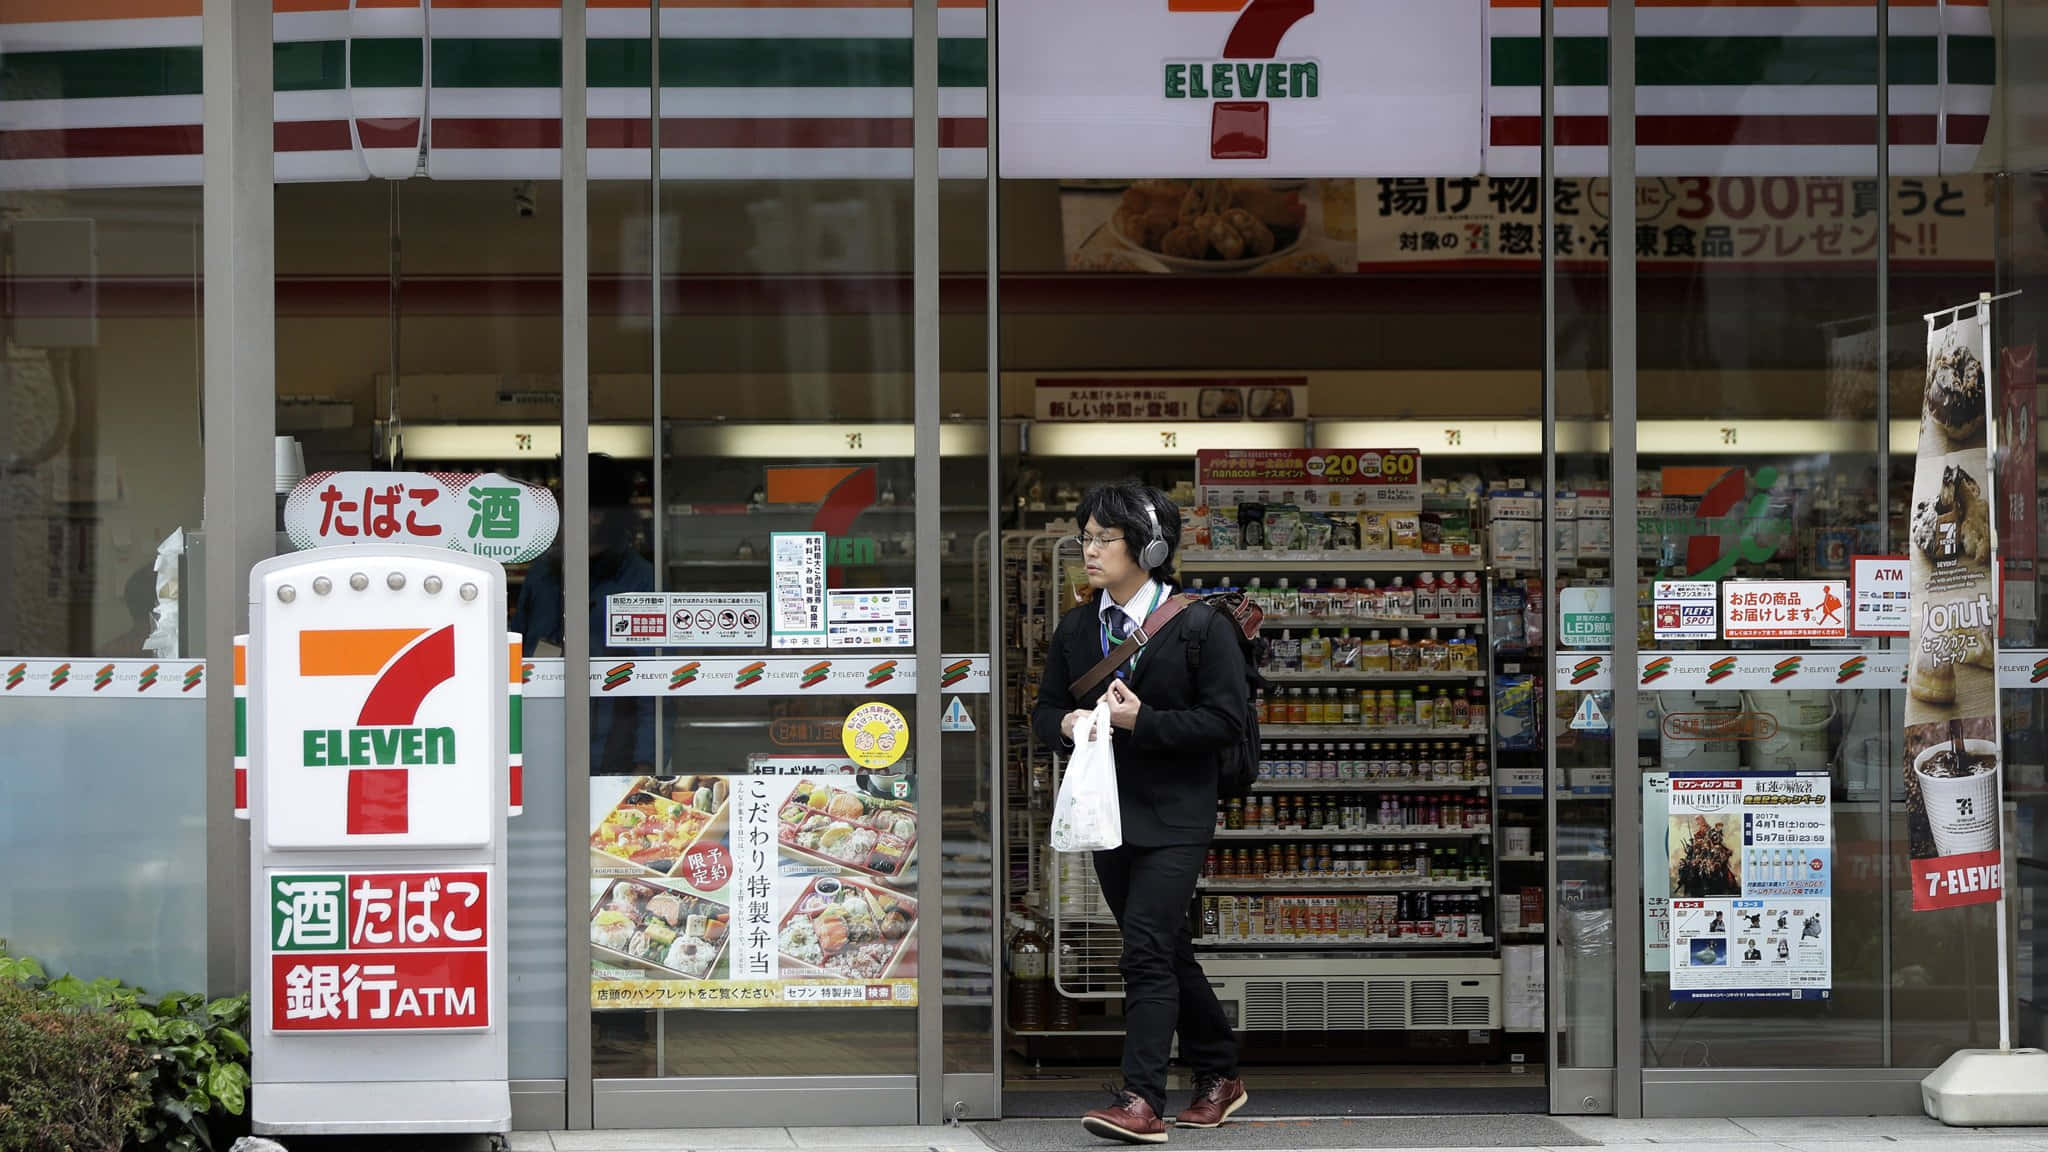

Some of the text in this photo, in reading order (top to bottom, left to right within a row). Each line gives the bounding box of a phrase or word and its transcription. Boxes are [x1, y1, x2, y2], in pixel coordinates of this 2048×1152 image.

[1325, 455, 1357, 475] 20
[1382, 455, 1414, 475] 60
[319, 484, 521, 539] たばこ 酒
[473, 541, 522, 558] liquor
[1875, 569, 1903, 580] ATM
[1730, 592, 1800, 606] お店の商品
[1684, 607, 1712, 616] FLET'S
[1730, 607, 1817, 622] お届けします。
[1685, 616, 1712, 625] SPOT
[1932, 651, 1967, 667] ドーナツ
[1673, 794, 1695, 804] FINAL
[1698, 793, 1729, 804] FANTASY
[747, 780, 771, 975] こだわり特製弁当
[1925, 863, 2000, 897] 7-ELEVE
[276, 877, 483, 948] 酒 たばこ
[285, 964, 476, 1020] 銀行ATM
[787, 987, 888, 999] セブン 特製弁当 検索
